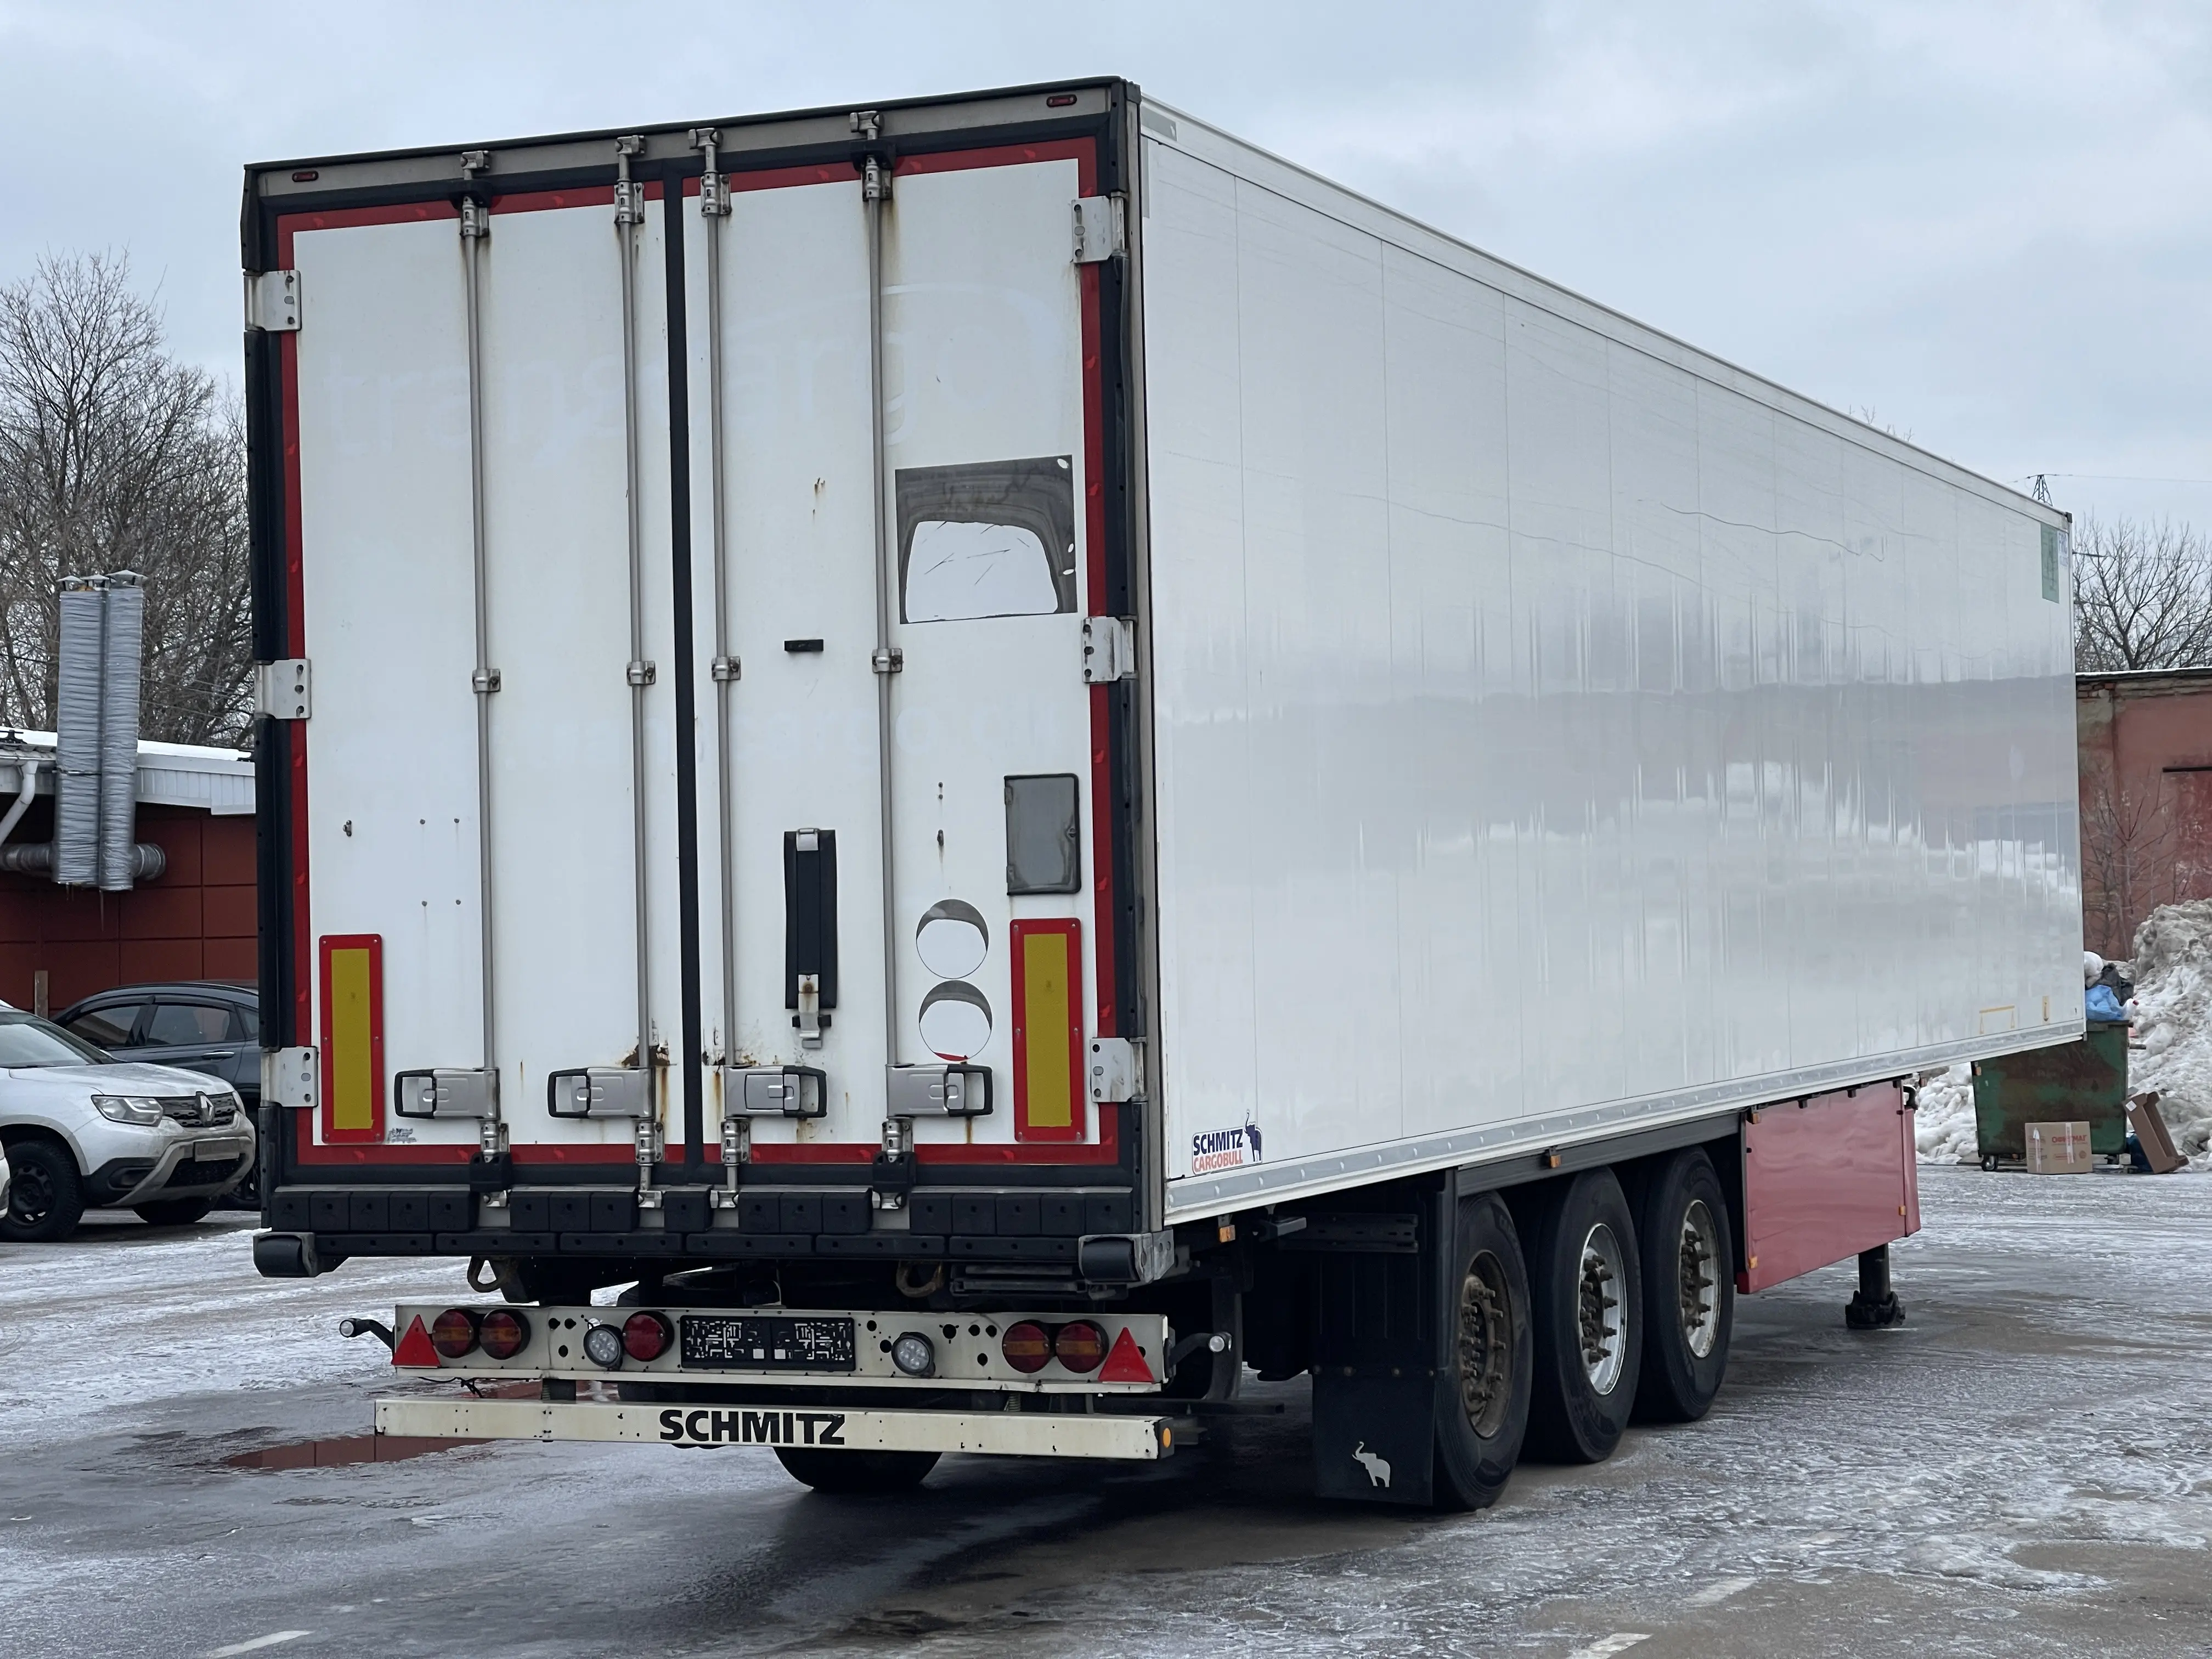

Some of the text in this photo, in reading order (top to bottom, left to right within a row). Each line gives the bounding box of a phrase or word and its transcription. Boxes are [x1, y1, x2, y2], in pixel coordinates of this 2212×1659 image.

[1193, 1128, 1243, 1156] SCHMITZ
[1194, 1150, 1243, 1172] CARGOBULL
[659, 1409, 845, 1444] SCHMITZ
